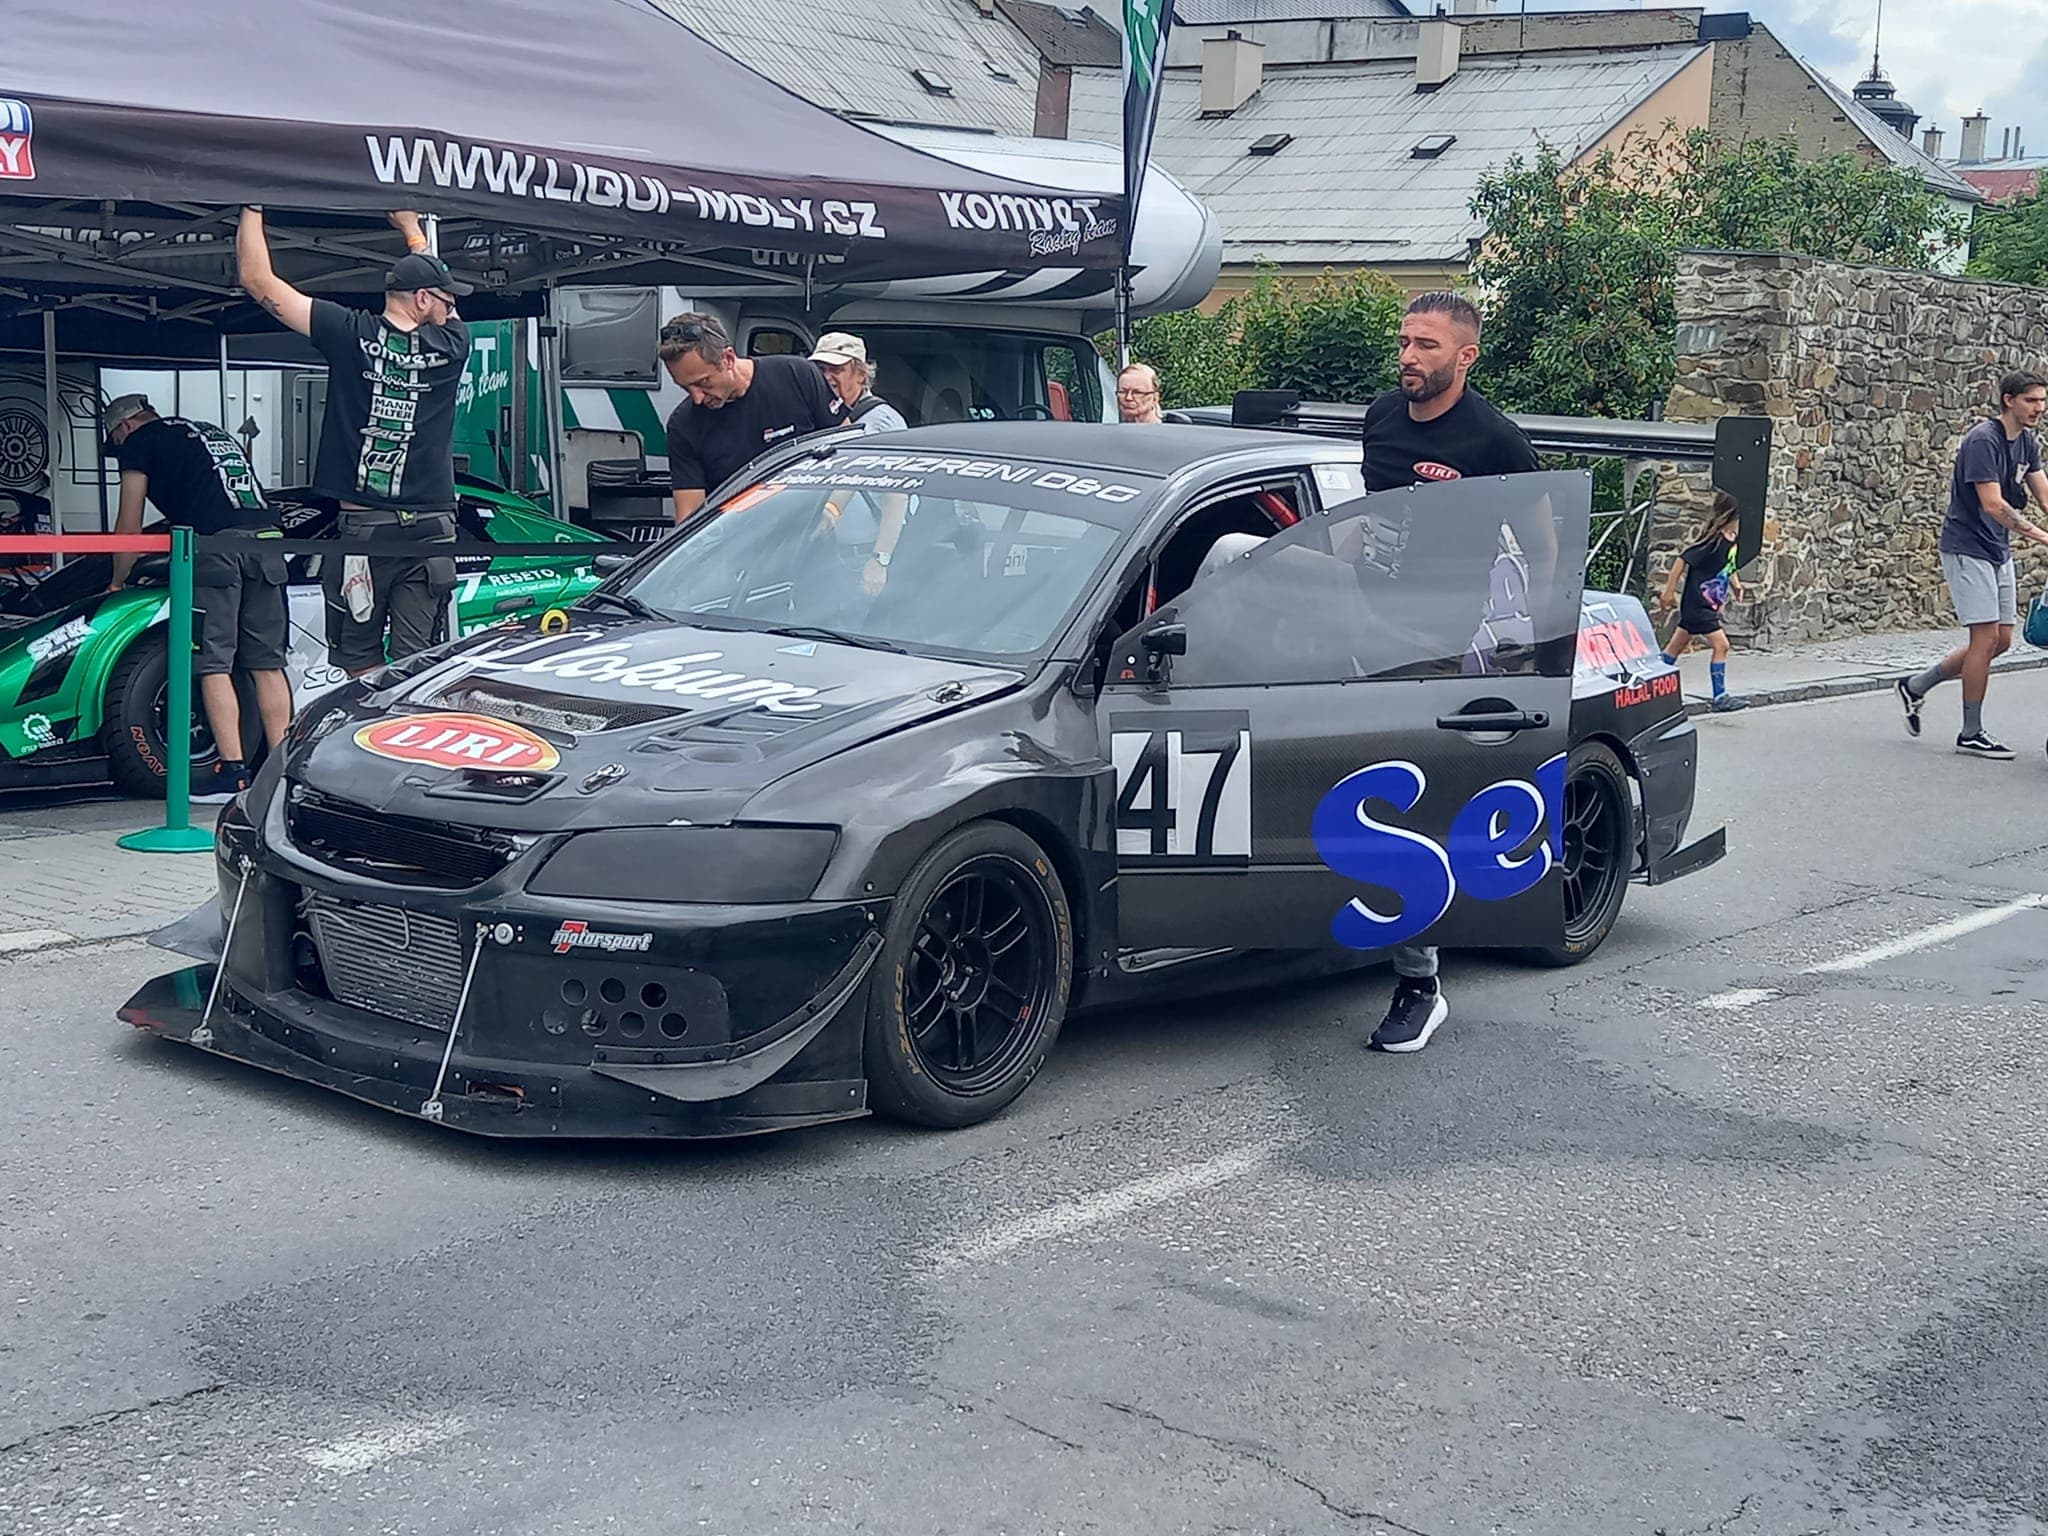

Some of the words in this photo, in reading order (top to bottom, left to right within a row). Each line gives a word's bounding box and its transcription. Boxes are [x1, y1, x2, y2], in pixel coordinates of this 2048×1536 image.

[365, 135, 887, 239] WWW.LIQUI-MOLY.CZ
[1028, 227, 1081, 258] Racing
[374, 407, 413, 419] FILTER
[375, 398, 414, 411] MANN
[842, 455, 1038, 483] PRIZRENI
[1614, 681, 1652, 709] HALAL
[1652, 674, 1679, 697] FOOD
[381, 725, 531, 764] LIRI
[1117, 731, 1241, 856] 47
[551, 930, 654, 952] motorsport
